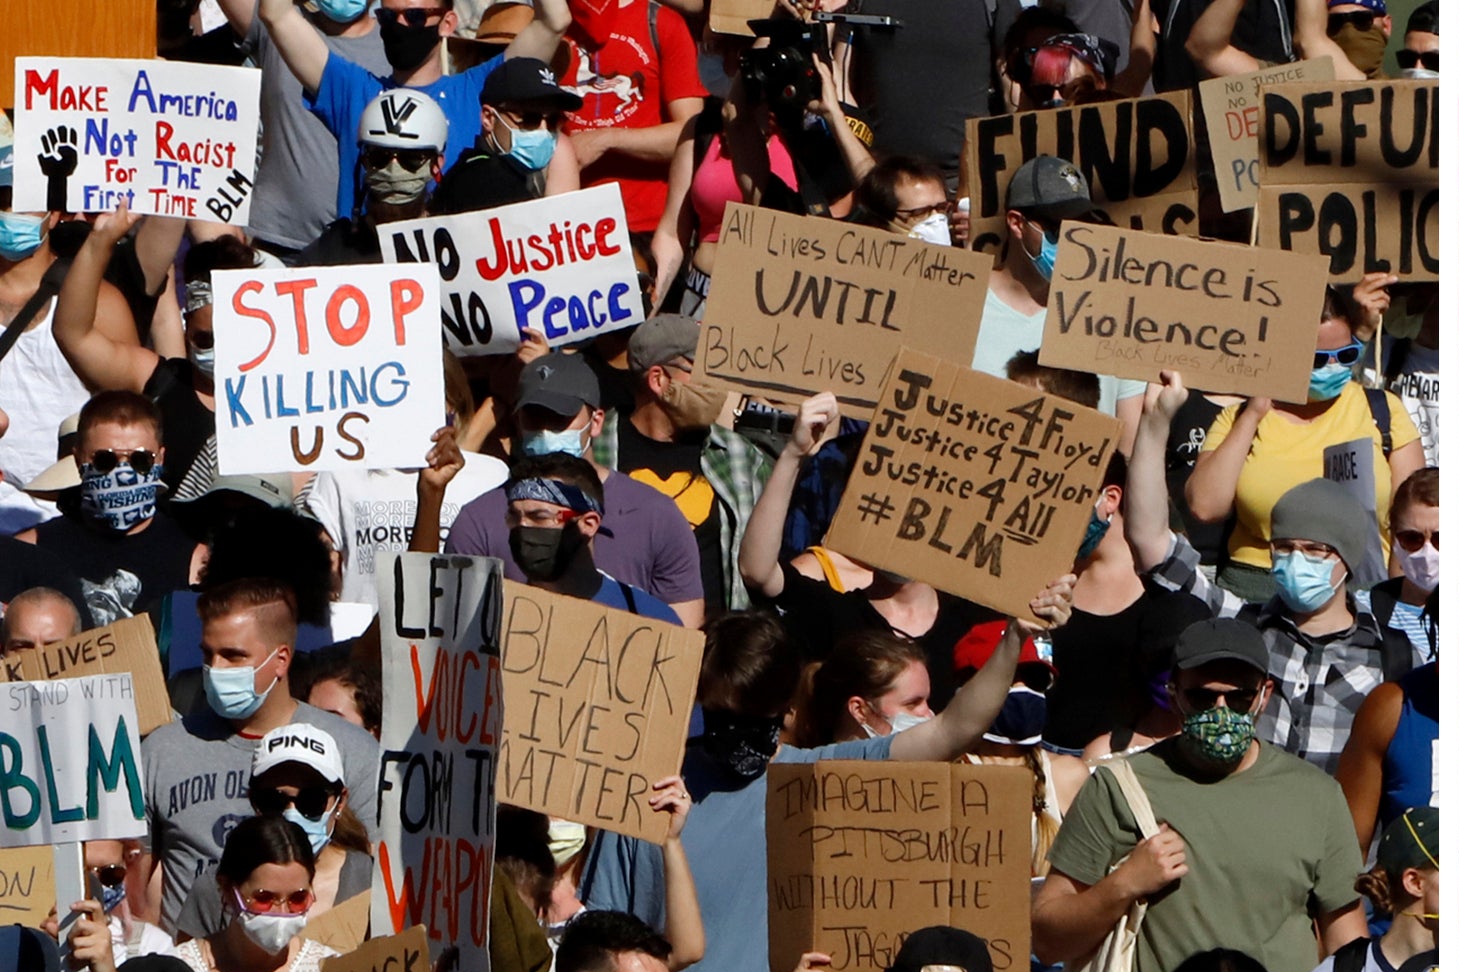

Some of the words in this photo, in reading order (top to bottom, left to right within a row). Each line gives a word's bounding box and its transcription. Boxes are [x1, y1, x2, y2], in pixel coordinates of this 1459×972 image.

[977, 99, 1189, 216] FUND
[1264, 86, 1439, 168] DEFU
[206, 168, 254, 223] BLM
[392, 225, 461, 281] NO
[475, 217, 622, 282] Justice
[722, 209, 755, 249] All
[767, 215, 826, 262] Lives
[902, 247, 975, 288] Matter
[1060, 226, 1233, 299] Silence
[1242, 268, 1282, 308] is
[230, 278, 426, 373] STOP
[508, 279, 632, 347] Peace
[755, 267, 902, 332] UNTIL
[703, 322, 790, 374] Black
[801, 333, 866, 386] Lives
[224, 361, 412, 429] KILLING
[289, 411, 372, 466] US
[394, 554, 474, 641] LET
[42, 633, 116, 678] LIVES
[502, 595, 676, 716] BLACK
[9, 681, 69, 712] STAND
[80, 677, 133, 700] WITH
[410, 643, 500, 746] VOICE
[0, 714, 146, 831] BLM
[268, 735, 326, 756] PING
[167, 772, 218, 819] AVON
[776, 771, 940, 820] IMAGINE
[961, 778, 989, 817] A
[797, 825, 1007, 869] PITTSBURGH
[379, 838, 494, 949] WEAPO
[773, 873, 910, 912] WITHOUT
[919, 877, 993, 910] THE
